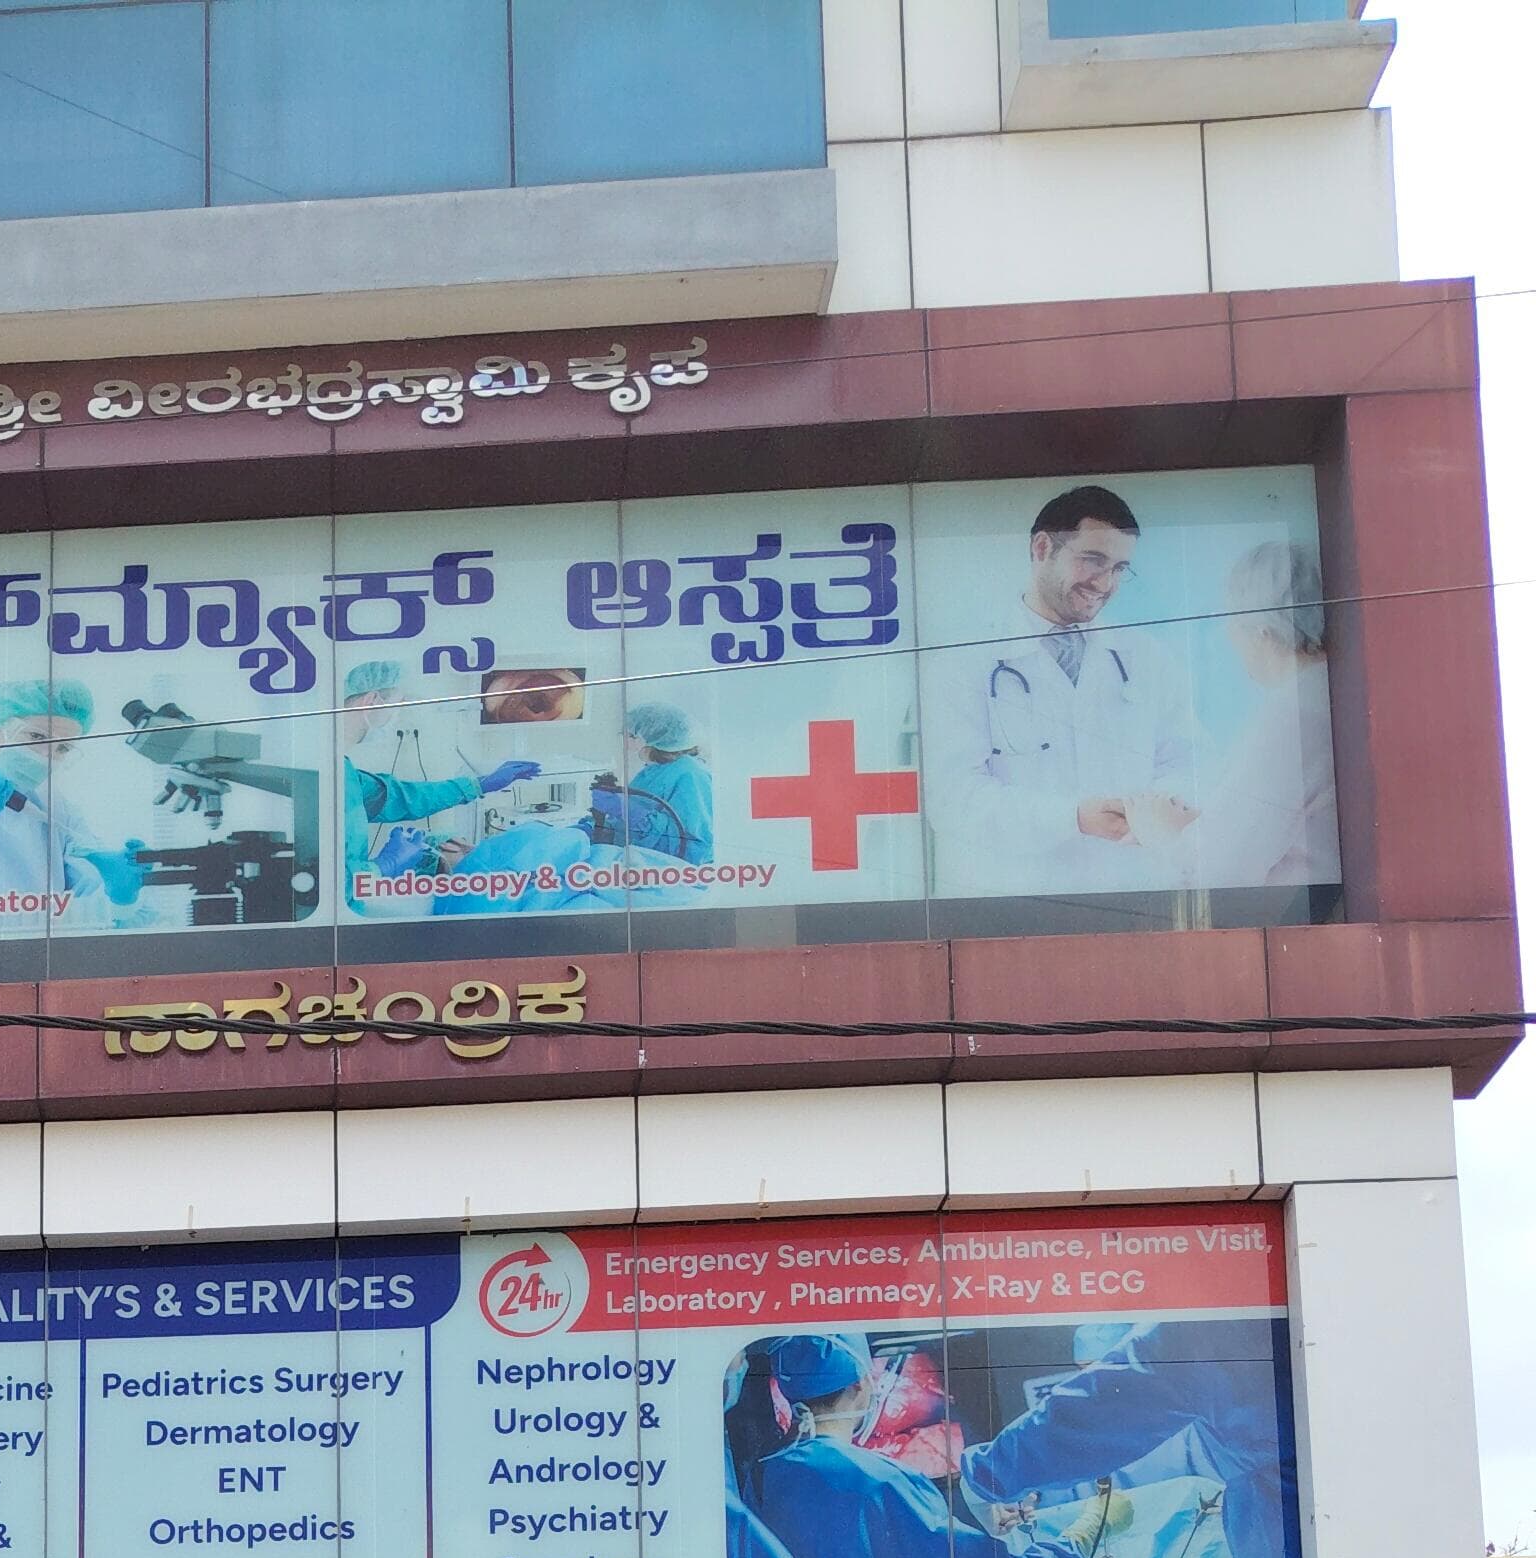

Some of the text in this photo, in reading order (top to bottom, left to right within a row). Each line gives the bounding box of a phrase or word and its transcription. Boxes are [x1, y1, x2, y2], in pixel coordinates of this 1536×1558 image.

[351, 861, 780, 905] Endoscopy & Colonoscopy
[606, 1226, 1272, 1278] Emergency Services, Ambulance, Home Visit,
[152, 1282, 184, 1317] &
[195, 1274, 416, 1315] SERVICES
[606, 1288, 764, 1316] Laboratory
[789, 1282, 944, 1308] Pharmacy,
[952, 1276, 1043, 1303] X-Ray
[1050, 1272, 1073, 1295] &
[1079, 1270, 1145, 1295] ECG
[101, 1366, 404, 1398] Pediatrics Surgery
[476, 1355, 677, 1388] Nephrology
[145, 1417, 360, 1448] Dermatology
[493, 1402, 661, 1436] Urology &
[218, 1466, 286, 1493] ENT
[488, 1456, 667, 1488] Andrology
[149, 1514, 355, 1547] Orthopedics
[489, 1505, 668, 1540] Psychiatry
